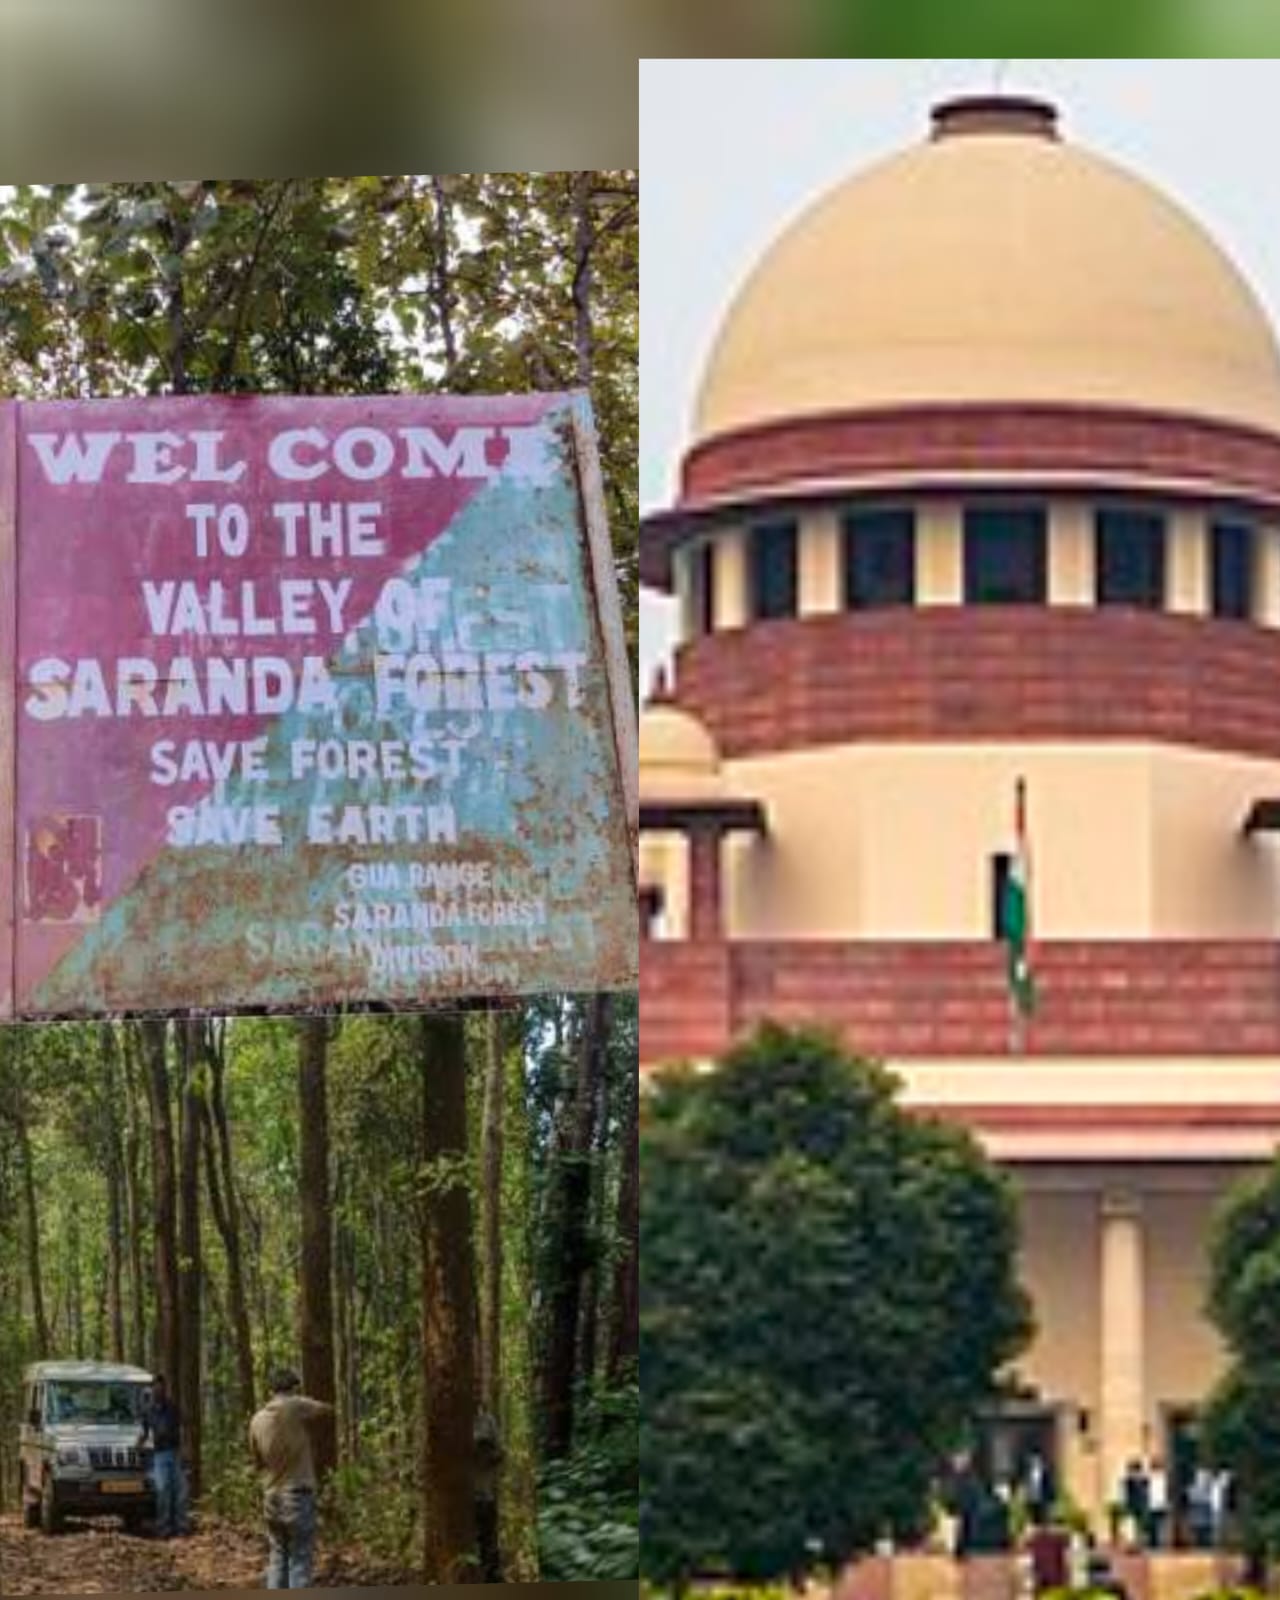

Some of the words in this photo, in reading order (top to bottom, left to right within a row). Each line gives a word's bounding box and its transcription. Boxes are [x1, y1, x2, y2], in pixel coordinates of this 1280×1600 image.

[185, 503, 249, 557] TO
[273, 501, 385, 557] THE
[142, 577, 353, 635] VALLEY
[374, 577, 450, 630] OF
[24, 656, 338, 721] SARANDA
[374, 651, 586, 718] FOREST
[150, 735, 269, 785] SAVE
[290, 738, 467, 780] FOREST
[166, 803, 284, 846] SAVE
[306, 803, 458, 844] EARTH
[348, 863, 400, 890] GUA
[333, 901, 461, 929] SARANDA
[467, 898, 547, 926] FOREST
